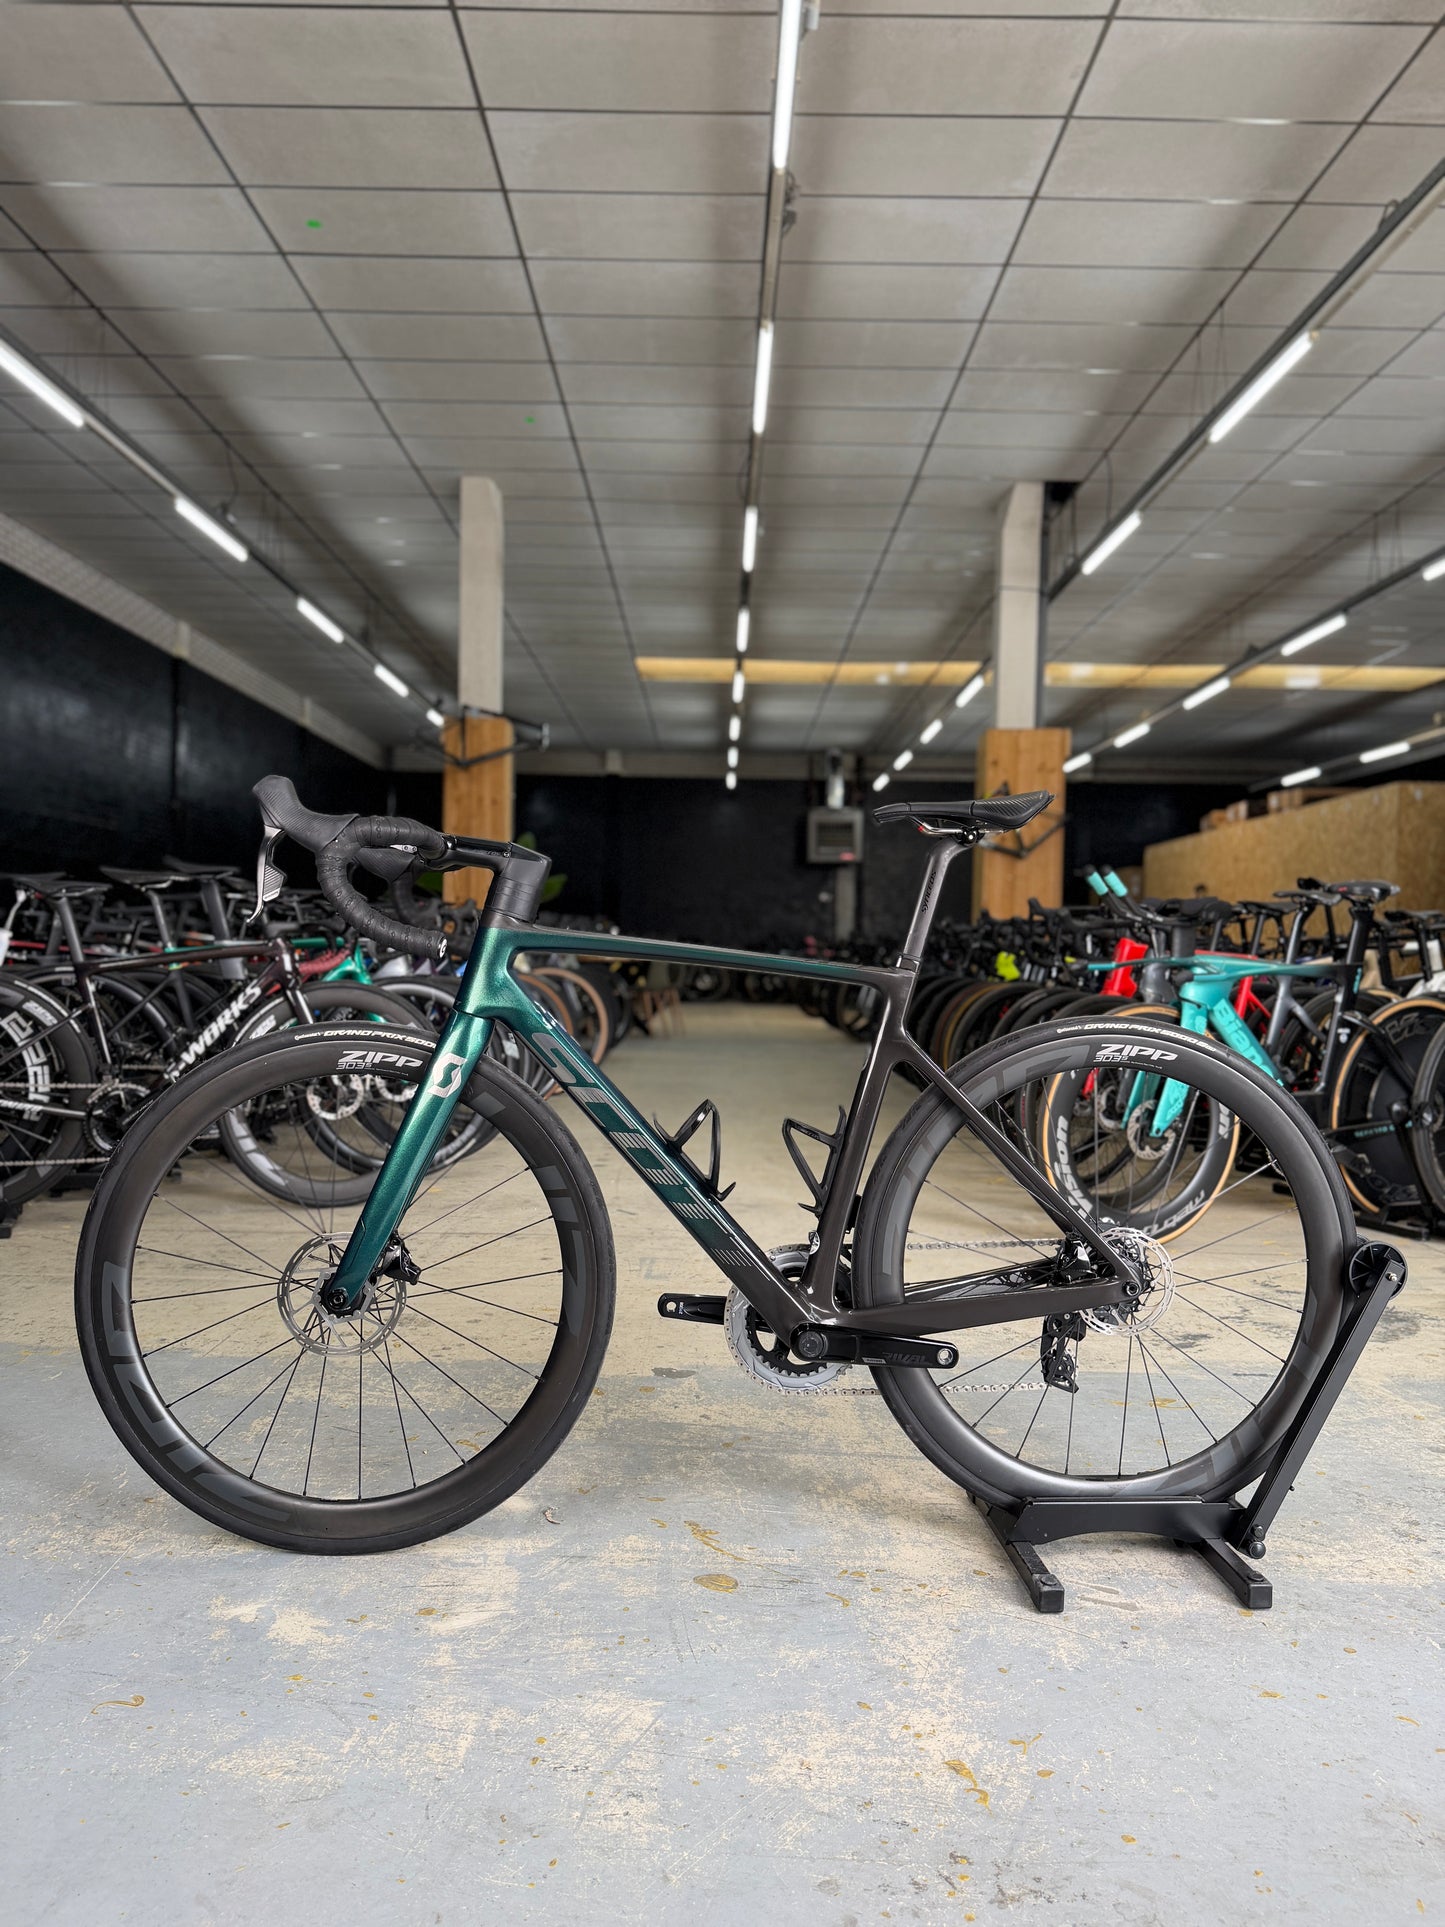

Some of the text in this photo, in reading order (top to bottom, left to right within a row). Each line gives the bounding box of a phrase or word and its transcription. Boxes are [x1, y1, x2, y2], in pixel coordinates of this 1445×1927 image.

[1128, 1024, 1161, 1034] PRIX
[323, 1029, 371, 1037] GRAND
[372, 1030, 406, 1040] PRIX
[404, 1036, 436, 1049] 500
[1213, 998, 1284, 1087] Bian
[337, 1050, 423, 1068] ZIPP
[1096, 1043, 1179, 1061] ZIPP
